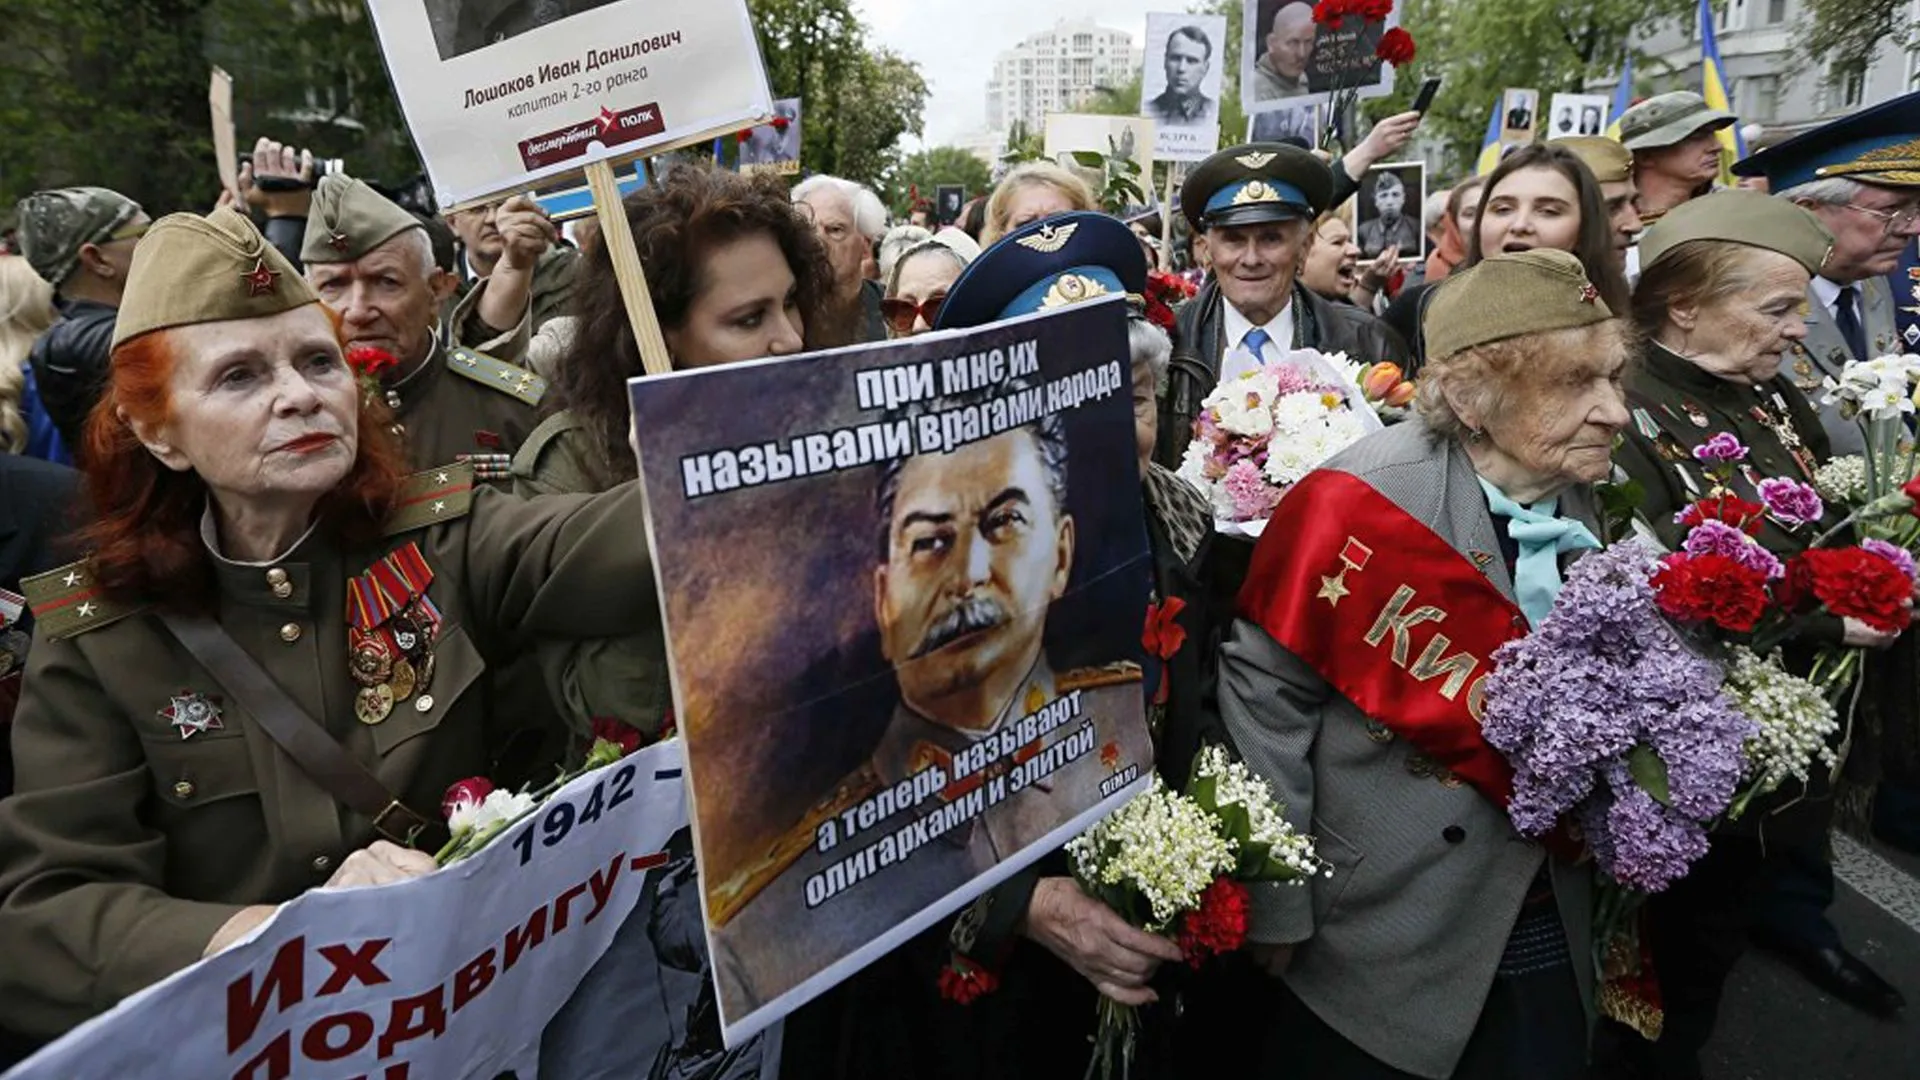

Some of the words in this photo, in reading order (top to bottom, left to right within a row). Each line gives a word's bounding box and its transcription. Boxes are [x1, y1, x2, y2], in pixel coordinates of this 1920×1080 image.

[463, 73, 535, 109] Лошаков
[538, 58, 581, 84] Иван
[585, 29, 682, 71] Данилович
[507, 91, 568, 120] капитан
[572, 81, 602, 99] 2-го
[606, 65, 649, 92] ранга
[681, 414, 913, 500] называли
[914, 386, 1044, 456] врагами
[1047, 358, 1123, 415] народа
[856, 362, 935, 411] при
[941, 349, 1005, 396] мне
[1006, 338, 1041, 380] их
[512, 764, 636, 867] 1942
[803, 792, 986, 908] олигархами
[987, 777, 1007, 806] и
[1008, 721, 1097, 793] элитой
[816, 819, 839, 853] а
[840, 764, 948, 840] теперь
[950, 688, 1084, 782] называют
[227, 934, 393, 1055] Их
